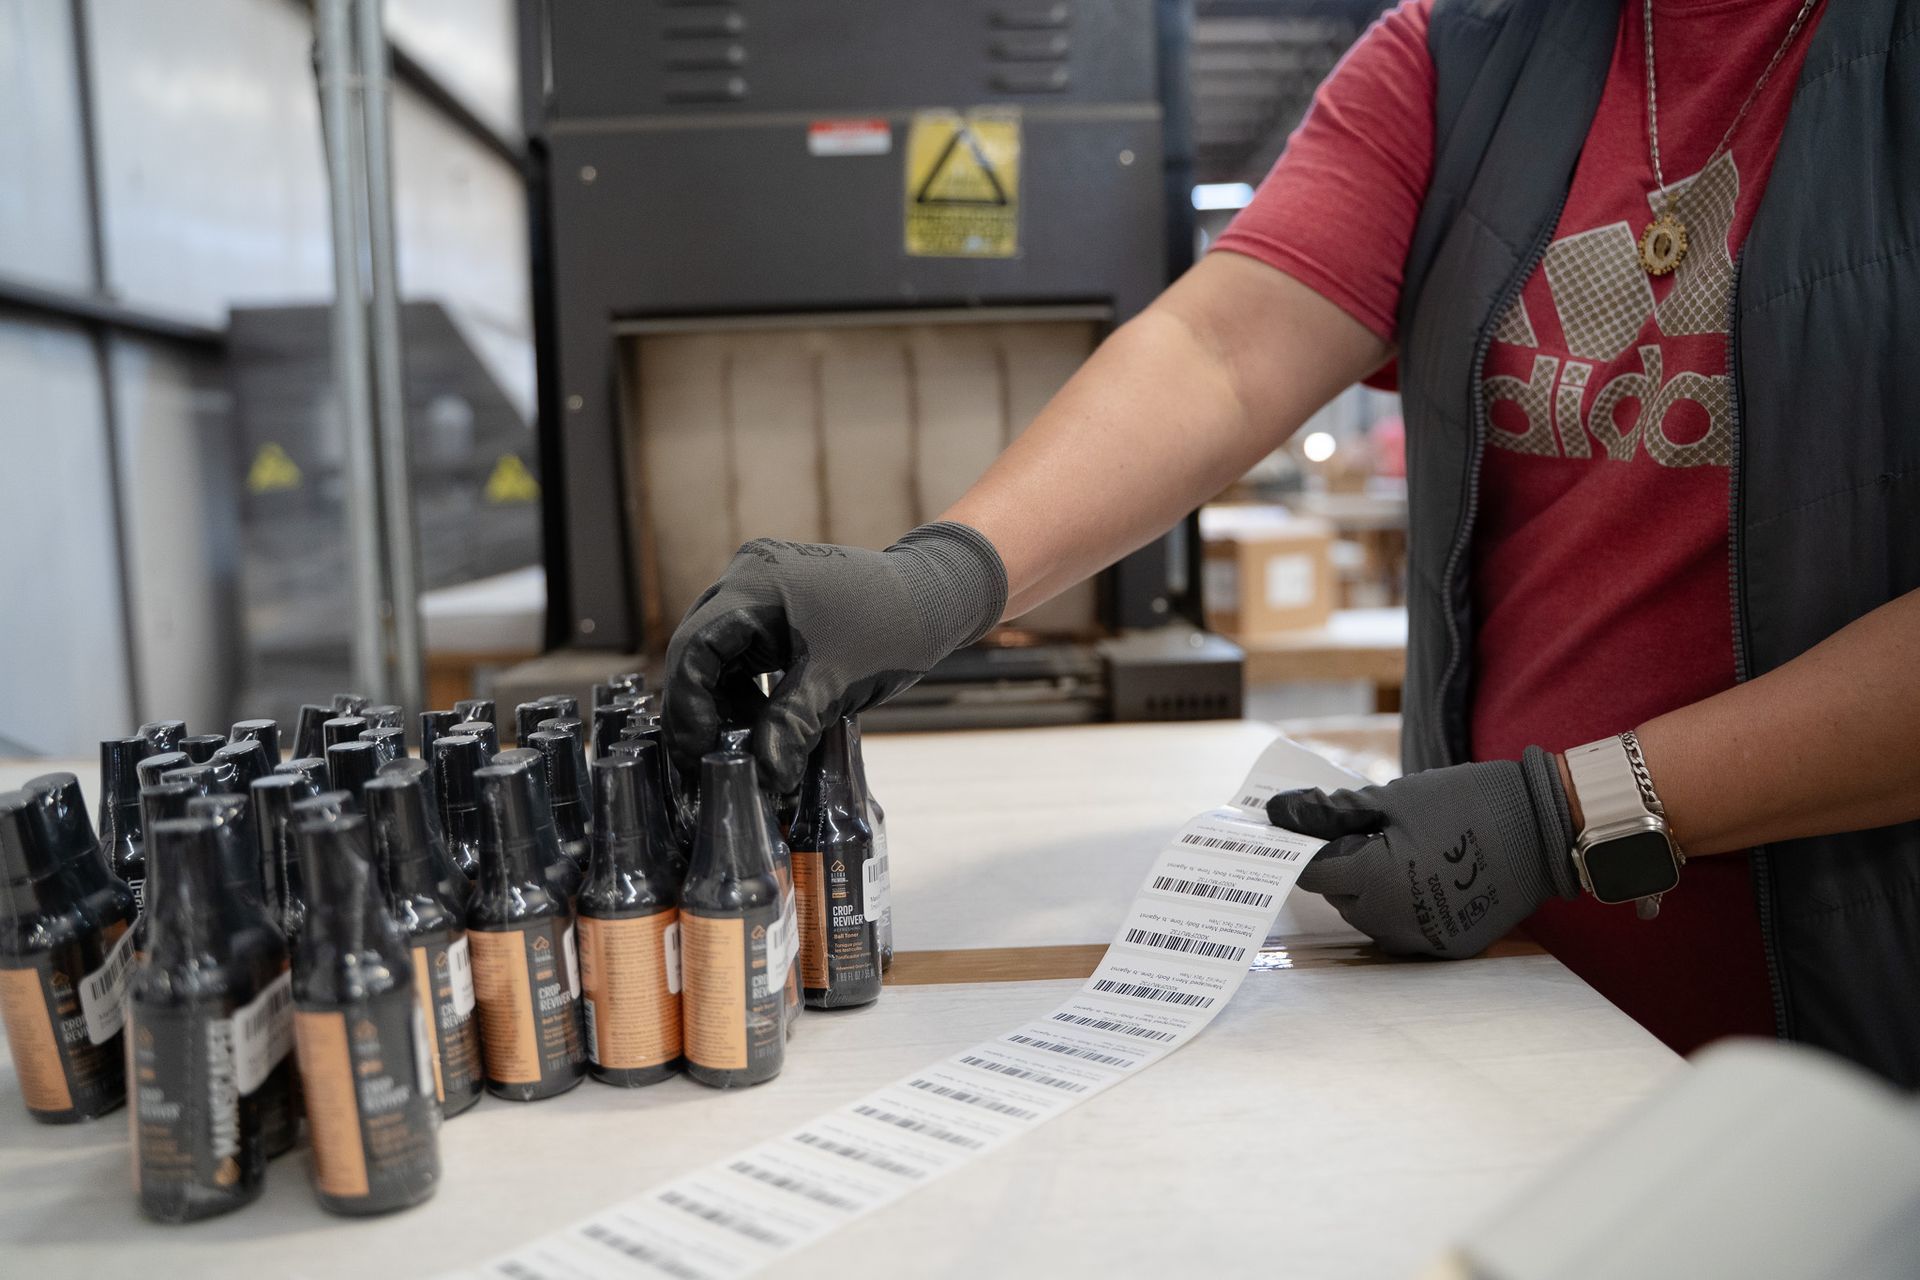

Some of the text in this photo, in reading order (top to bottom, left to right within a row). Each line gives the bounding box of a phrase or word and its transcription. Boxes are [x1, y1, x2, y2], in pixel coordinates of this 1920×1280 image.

[1481, 345, 1730, 467] dida
[832, 905, 853, 916] CROP
[833, 914, 863, 927] REVIVER
[1220, 928, 1253, 938] Manscaped
[538, 983, 560, 1000] CROP
[541, 991, 572, 1011] REVIVER
